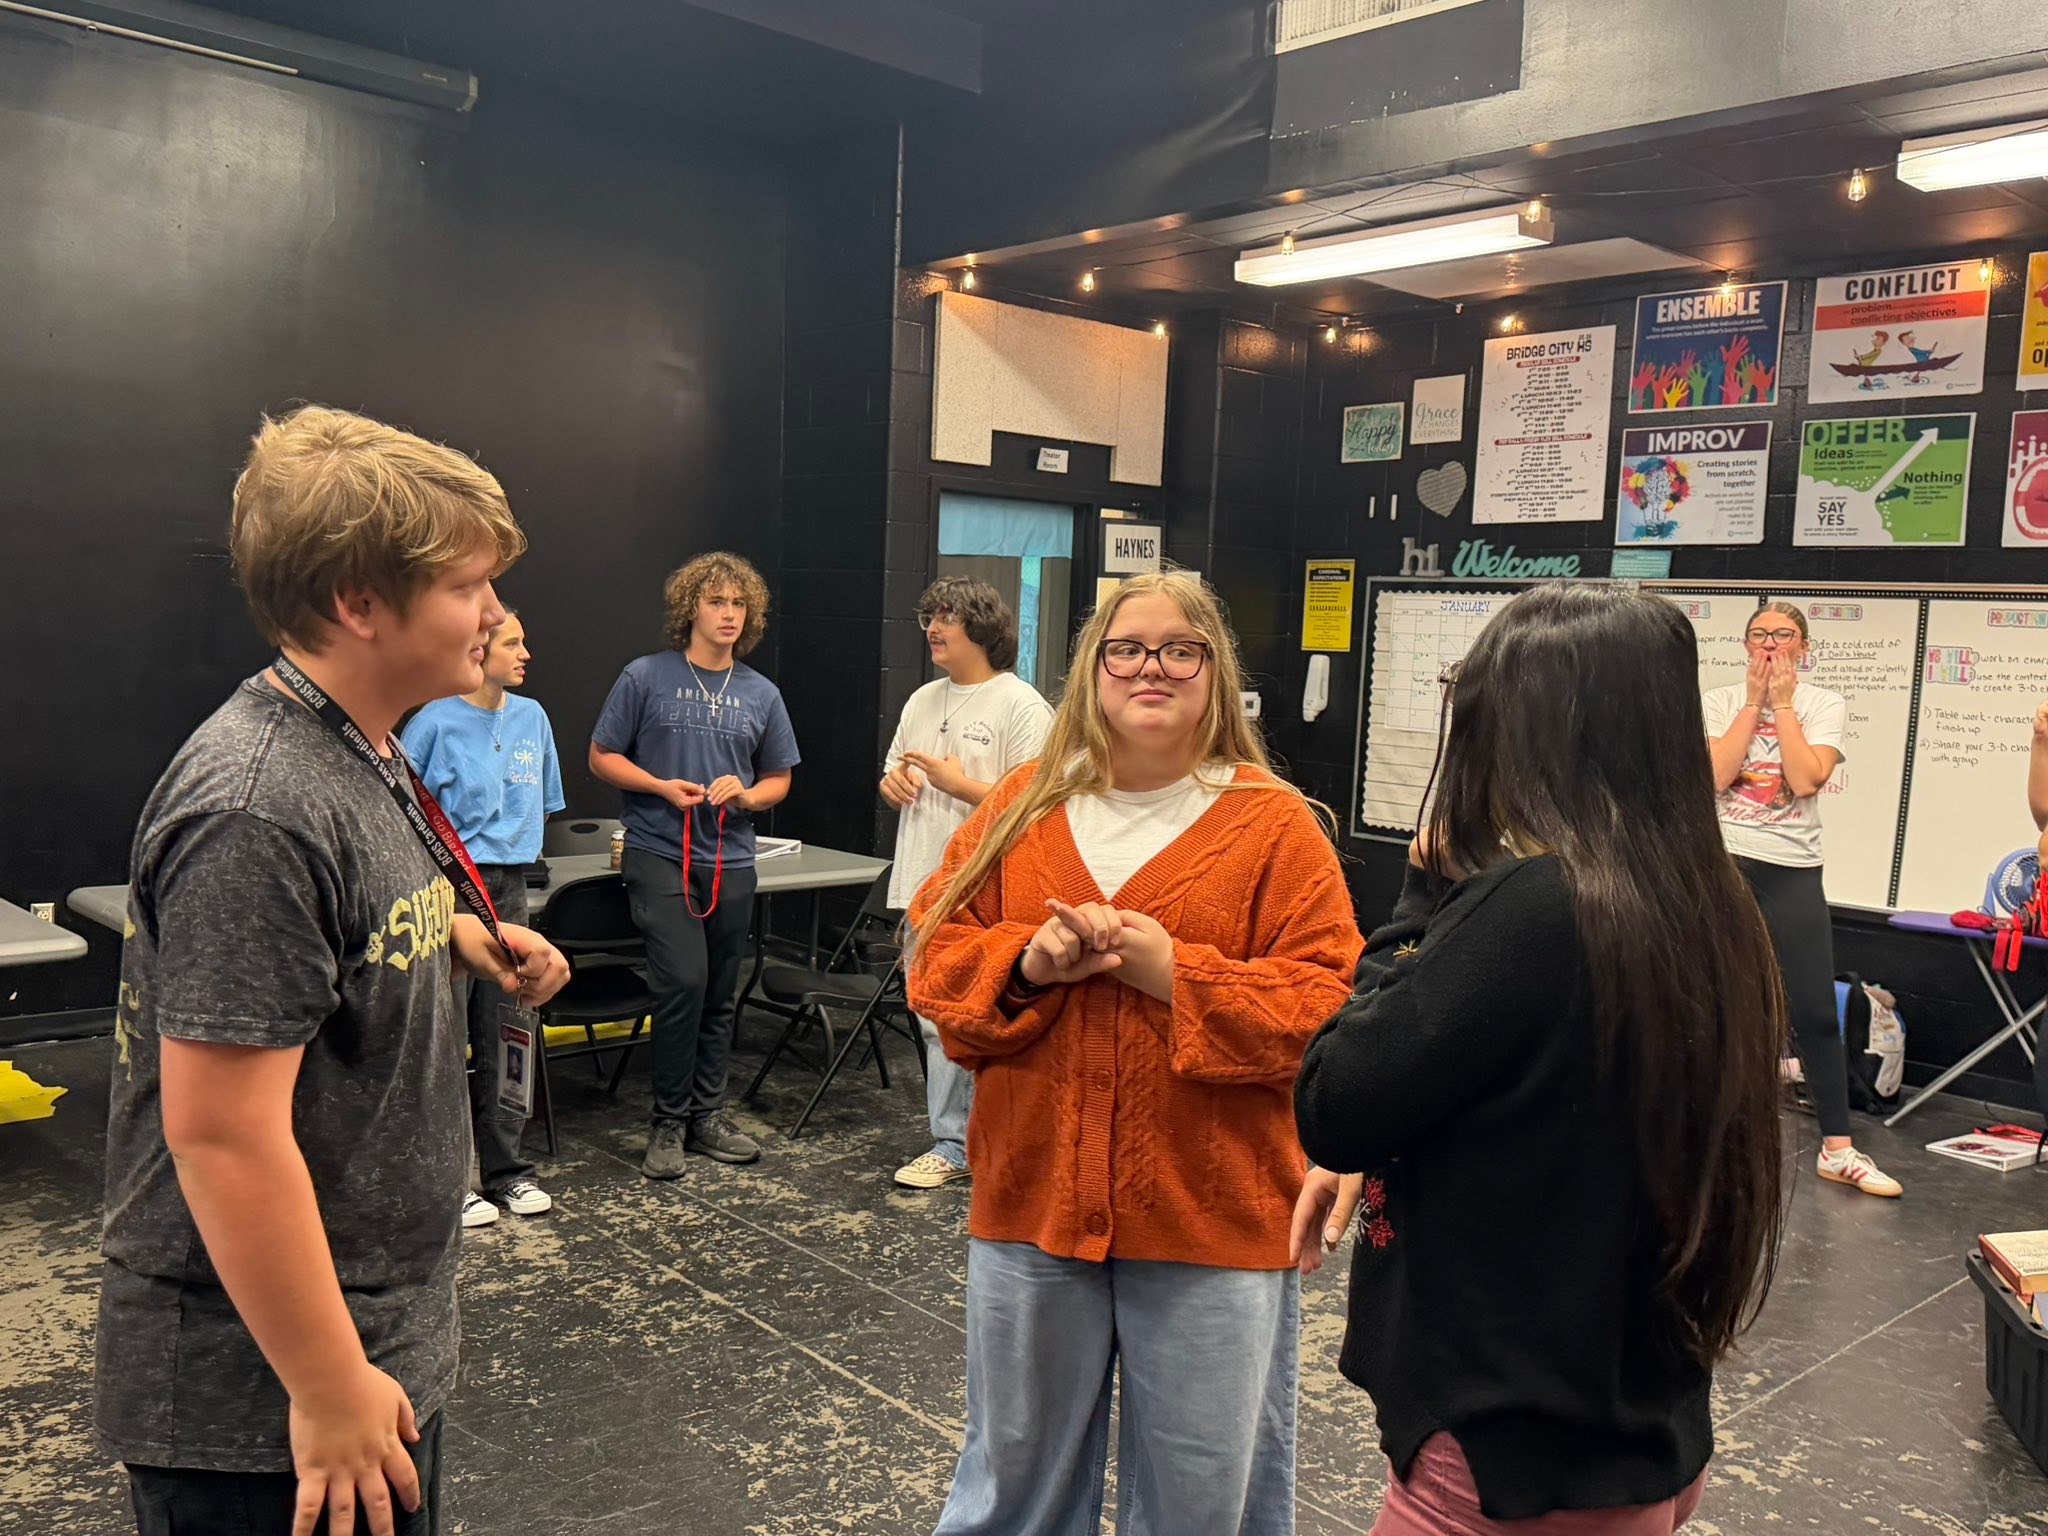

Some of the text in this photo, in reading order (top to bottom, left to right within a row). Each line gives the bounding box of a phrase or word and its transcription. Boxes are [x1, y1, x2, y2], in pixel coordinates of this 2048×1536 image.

[1845, 268, 1961, 301] CONFLICT
[1656, 290, 1761, 323] ENSEMBLE
[1851, 303, 1892, 314] problem
[1851, 308, 1957, 326] conflicting objectives
[1577, 339, 1592, 352] HS
[1415, 403, 1460, 424] Grace
[1425, 419, 1460, 428] CHANGES
[1414, 428, 1459, 439] EVERYTHING
[1807, 418, 1907, 446] OFFER
[1648, 428, 1746, 453] IMPROV
[1043, 450, 1061, 459] Theater
[1814, 447, 1854, 459] Ideas
[1043, 461, 1058, 469] Room
[1697, 459, 1758, 468] Creating stories
[1727, 469, 1757, 477] scratch,
[1904, 470, 1963, 485] Nothing
[1723, 480, 1756, 488] together
[1817, 501, 1847, 514] SAY
[1817, 514, 1845, 526] YES
[1115, 538, 1155, 559] HAYNES
[1401, 537, 1445, 576] hi
[1452, 538, 1582, 578] Welcome
[1440, 600, 1491, 613] JANUARY
[1818, 639, 1831, 649] do
[1842, 639, 1862, 649] cold
[1863, 638, 1884, 649] read
[1888, 639, 1901, 648] of
[1980, 654, 2005, 662] work
[1816, 664, 1838, 673] read
[1840, 664, 1863, 673] aloud
[1876, 664, 1909, 676] silently
[1996, 672, 2011, 681] the
[2014, 672, 2047, 681] context
[1871, 674, 1887, 682] and
[1843, 682, 1886, 691] participate
[1888, 683, 1897, 691] in
[1970, 683, 2038, 693] to create 3-D
[300, 682, 327, 709] BCHS
[675, 687, 740, 708] AMERICAN
[1934, 707, 1959, 720] Table
[1962, 712, 1986, 722] work
[1968, 726, 1981, 736] up
[1932, 739, 1960, 750] Share
[1965, 743, 1983, 753] your
[1987, 742, 2008, 752] 3-D
[342, 722, 397, 789] BCHS Cardinals
[1931, 753, 1979, 768] with group
[406, 802, 454, 867] BCHS Cardinals
[433, 815, 446, 831] Go
[441, 831, 457, 852] Big
[460, 880, 492, 921] Cardinals
